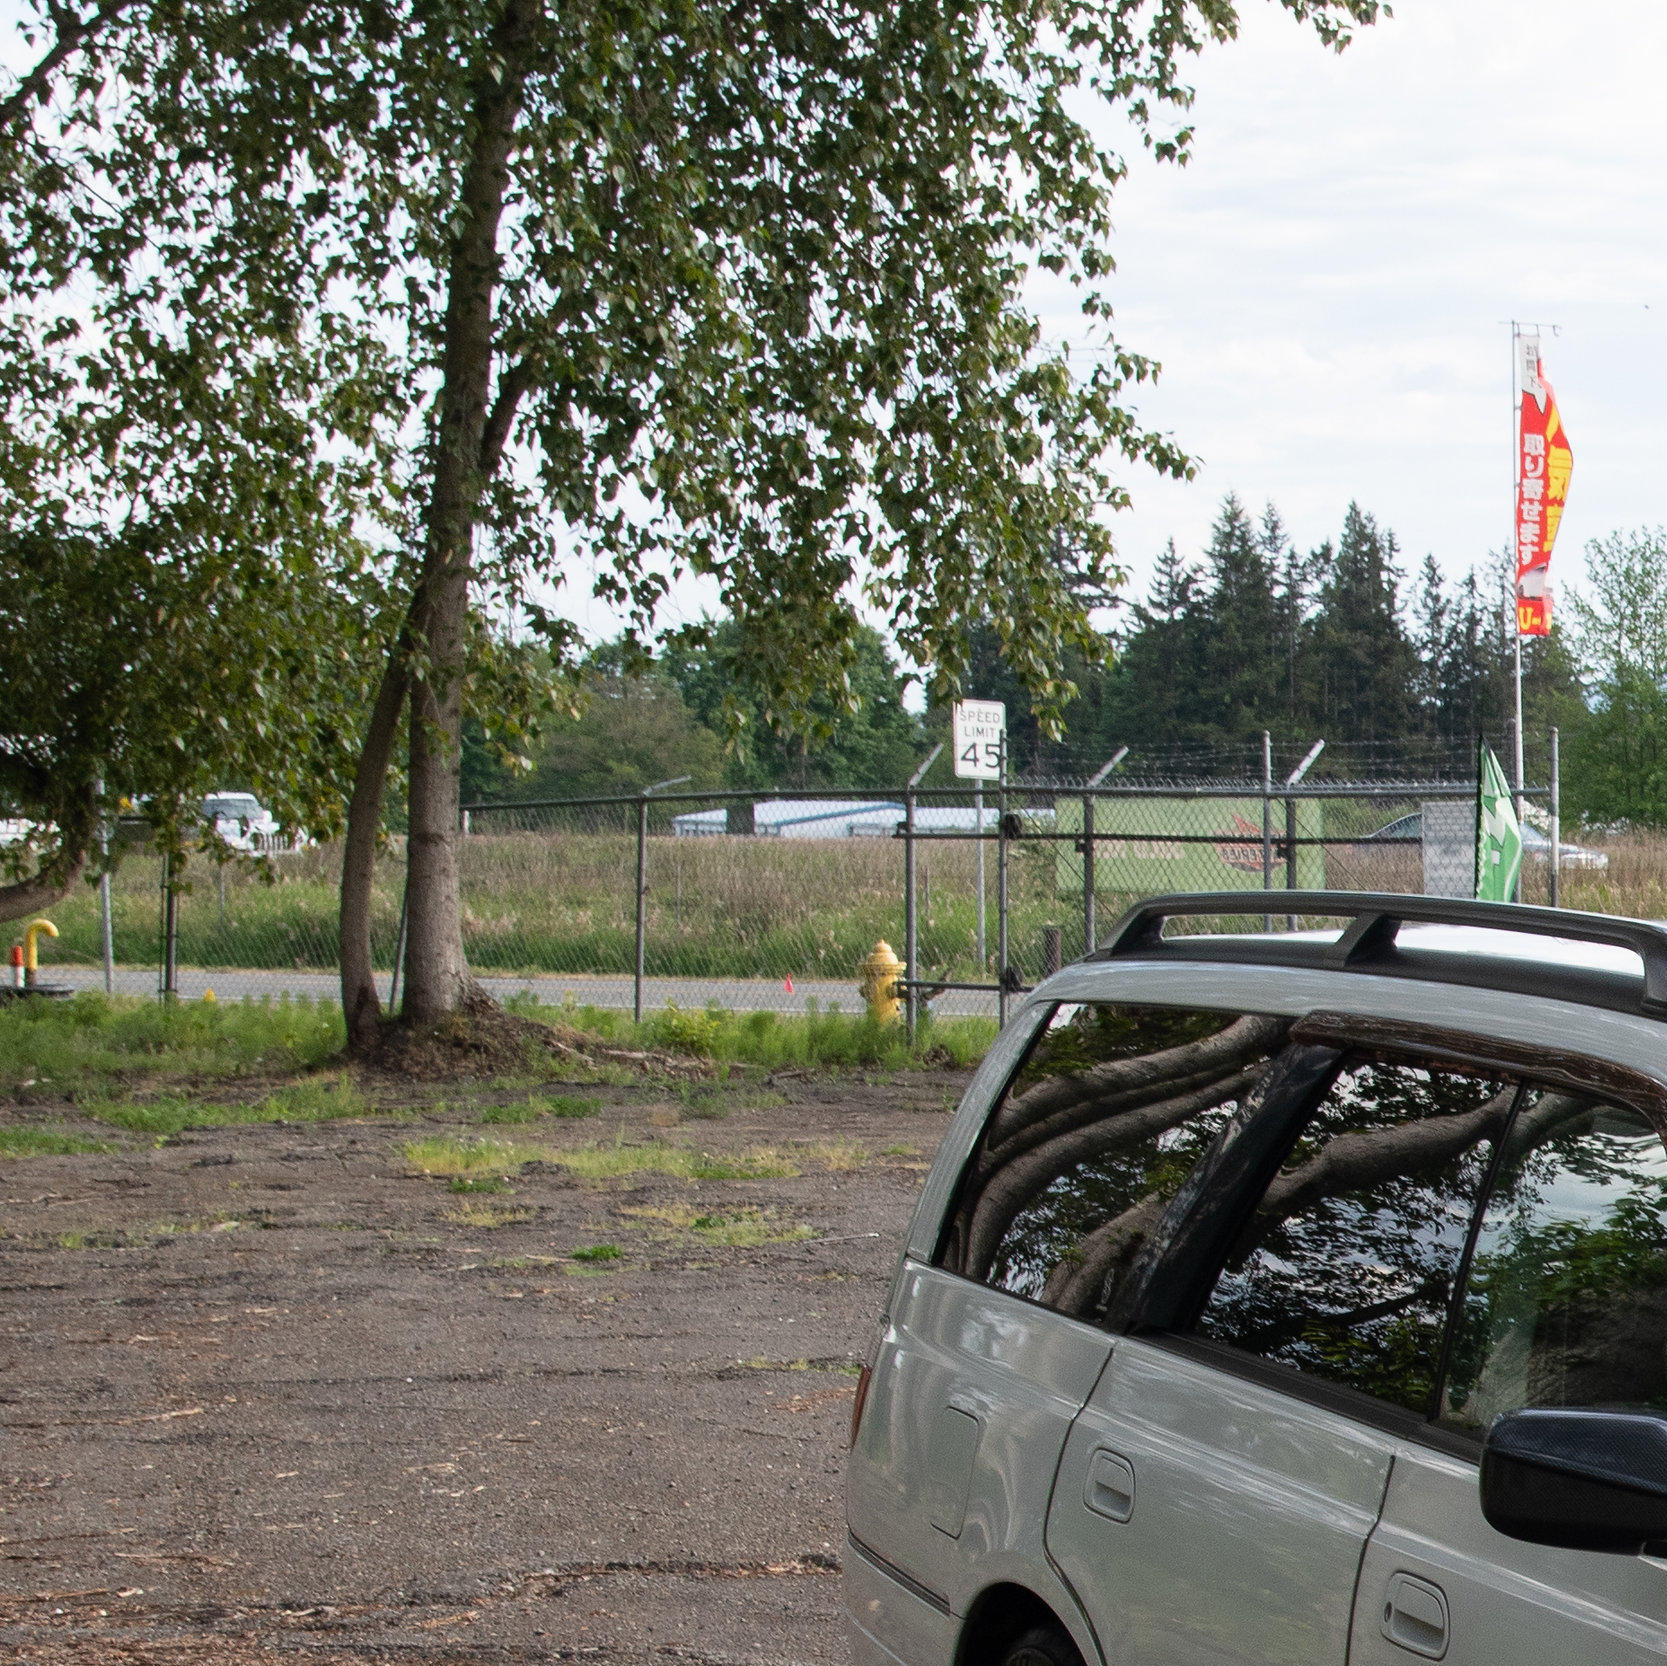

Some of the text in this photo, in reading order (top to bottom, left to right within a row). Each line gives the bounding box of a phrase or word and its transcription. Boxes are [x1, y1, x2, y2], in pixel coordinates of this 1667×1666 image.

[1519, 433, 1545, 564] 取り寄せます
[960, 711, 1000, 723] SPEED
[964, 726, 996, 738] LIMIT
[961, 742, 1001, 768] 45
